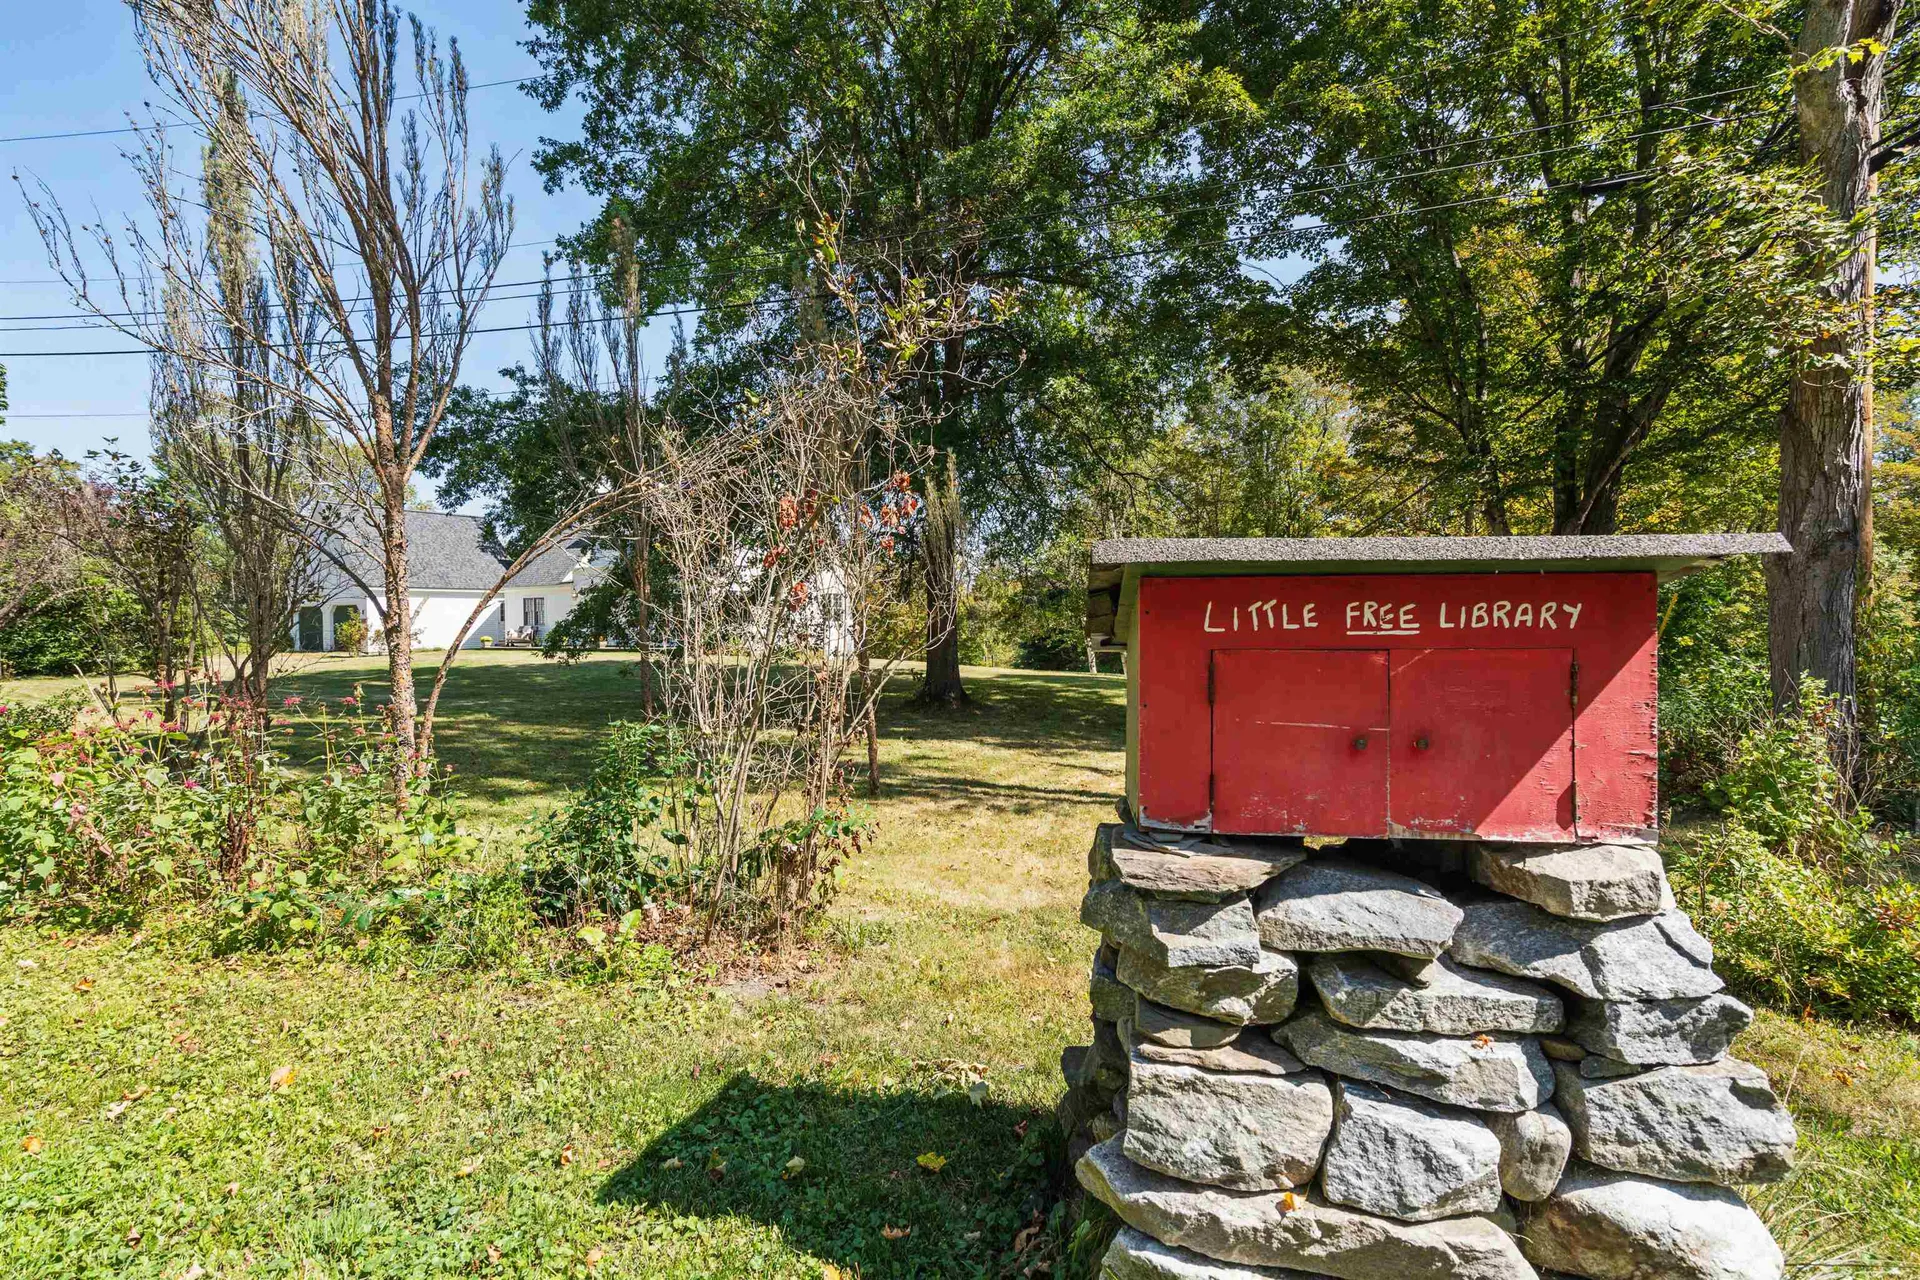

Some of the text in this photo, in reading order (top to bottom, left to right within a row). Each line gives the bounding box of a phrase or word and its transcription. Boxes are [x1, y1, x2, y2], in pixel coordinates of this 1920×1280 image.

[1203, 600, 1583, 633] LITTLE FREE LIBRARY
